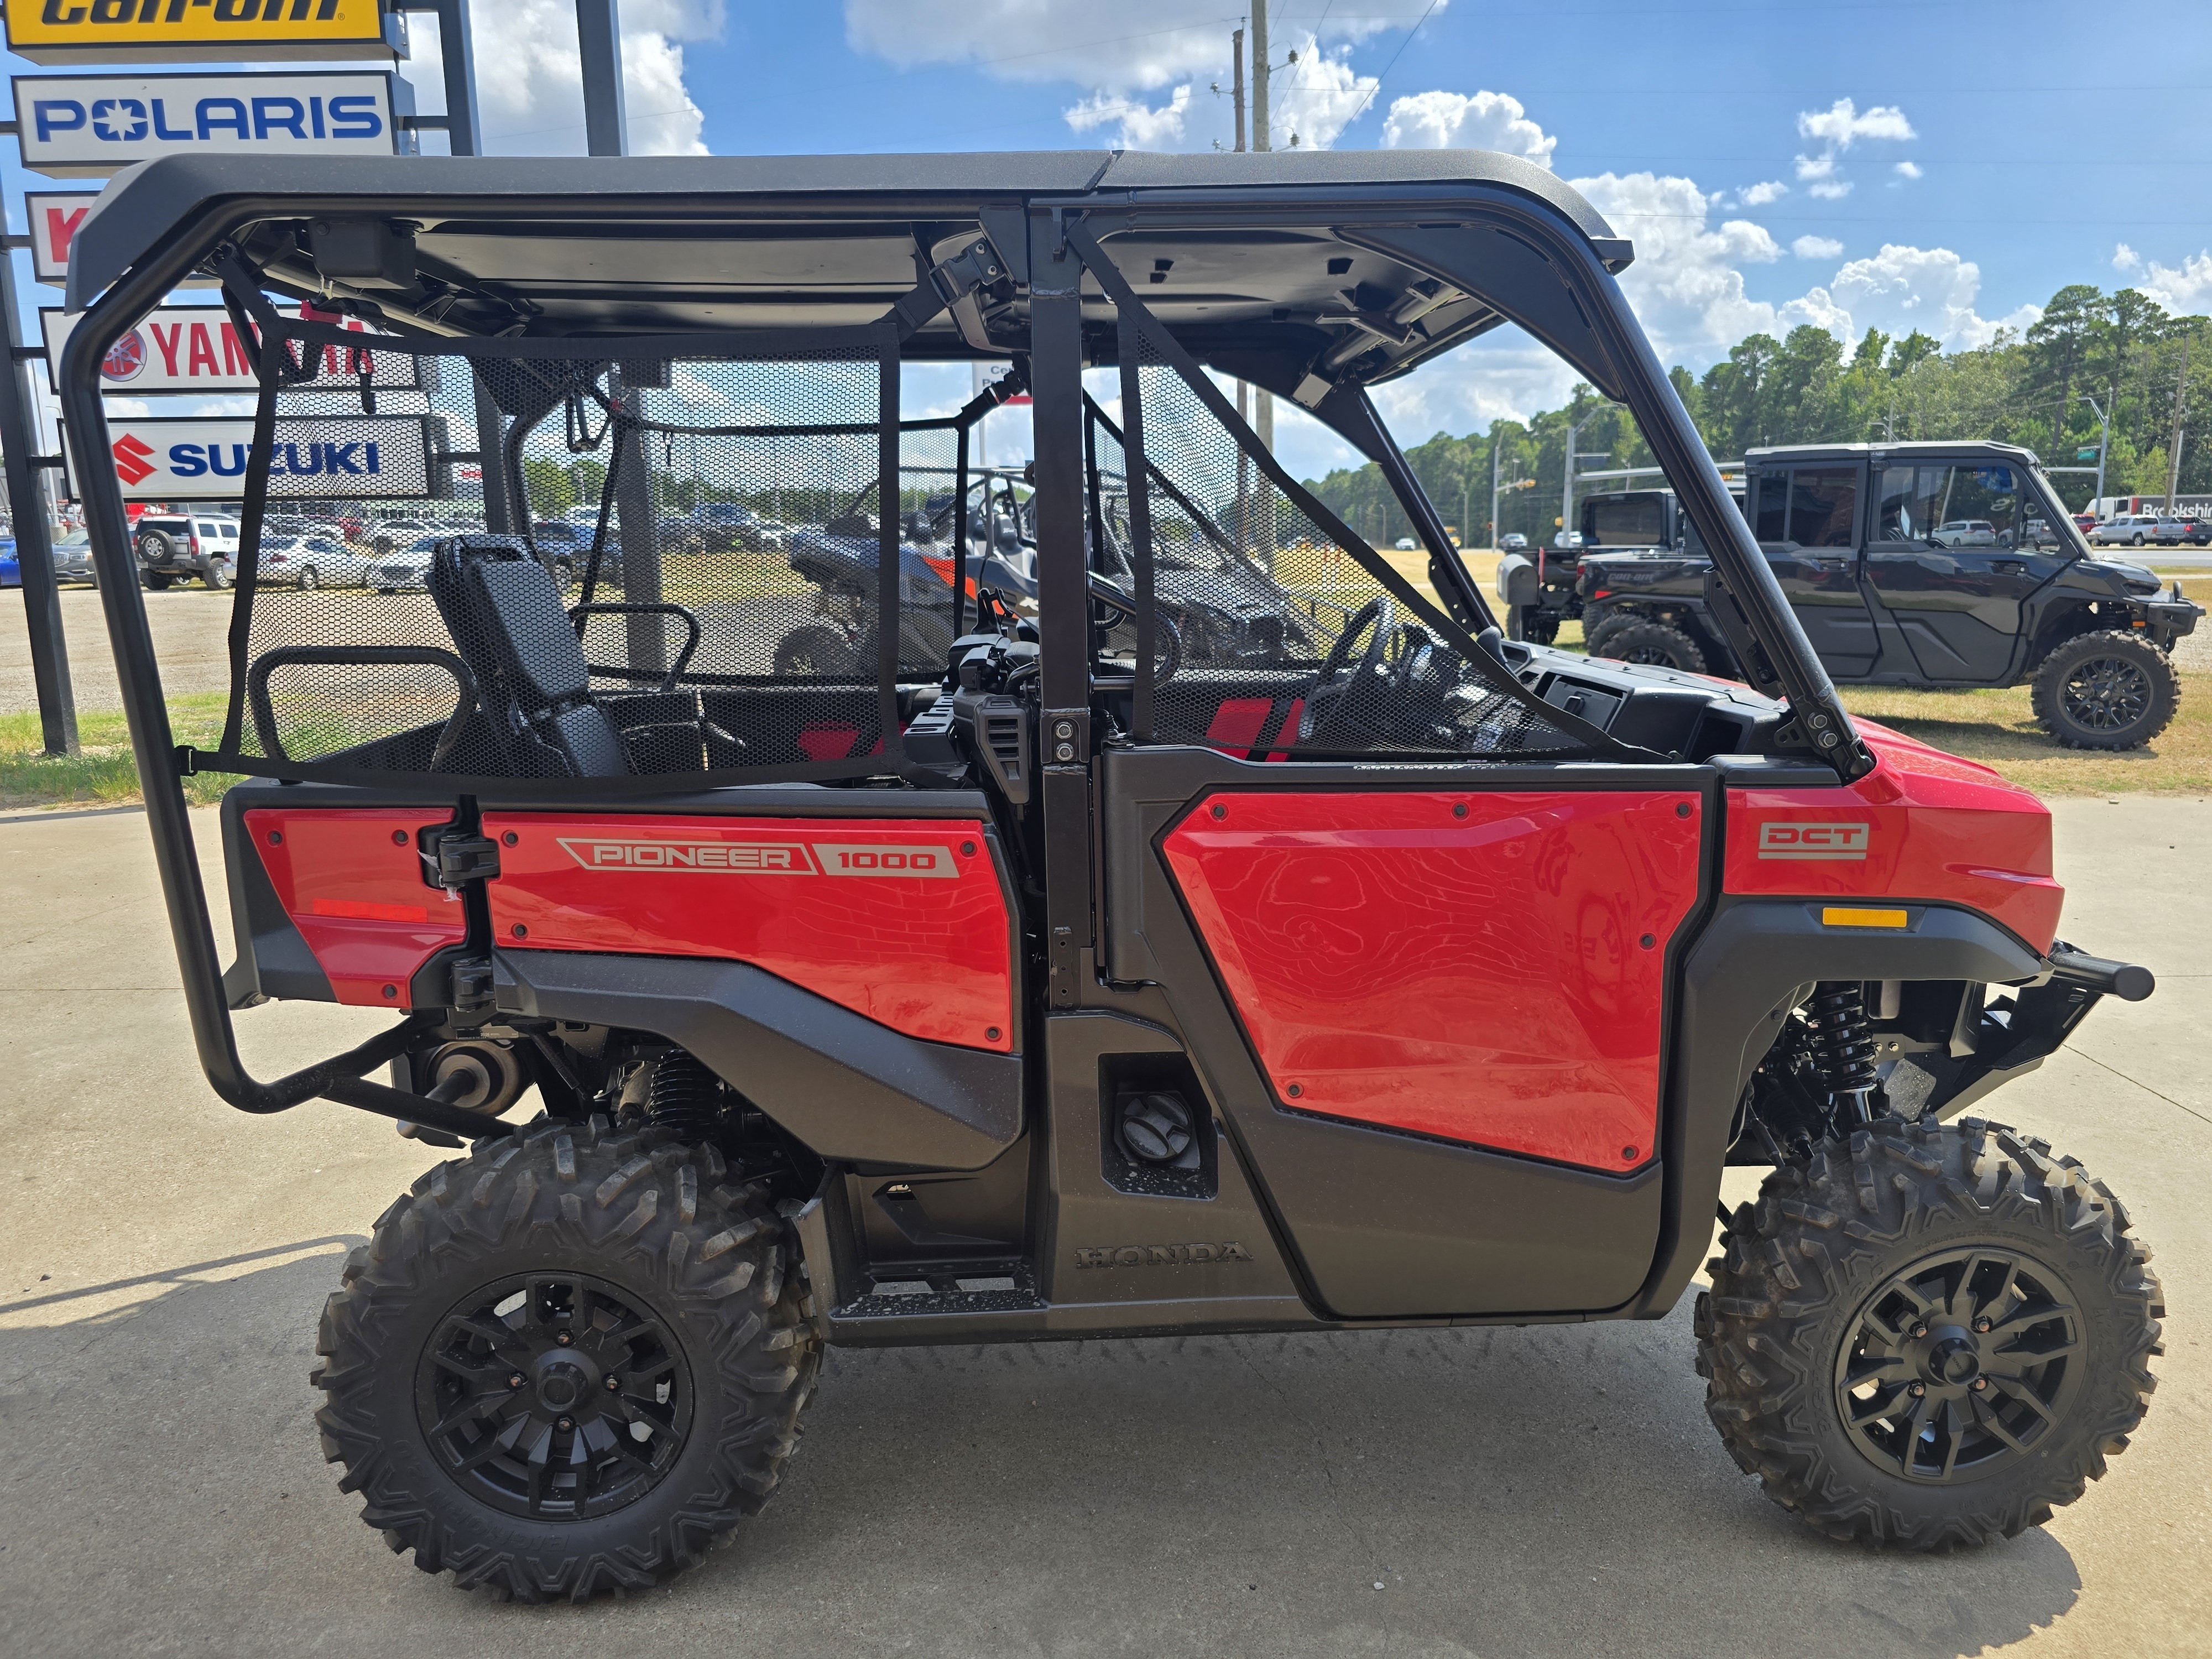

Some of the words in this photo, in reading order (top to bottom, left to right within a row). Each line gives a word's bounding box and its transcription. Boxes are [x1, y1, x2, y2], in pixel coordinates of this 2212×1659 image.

[34, 96, 383, 142] POLARIS
[1767, 828, 1861, 844] DCT
[593, 845, 791, 868] PIONEER
[837, 852, 936, 869] 1000
[1076, 1241, 1254, 1269] HONDA
